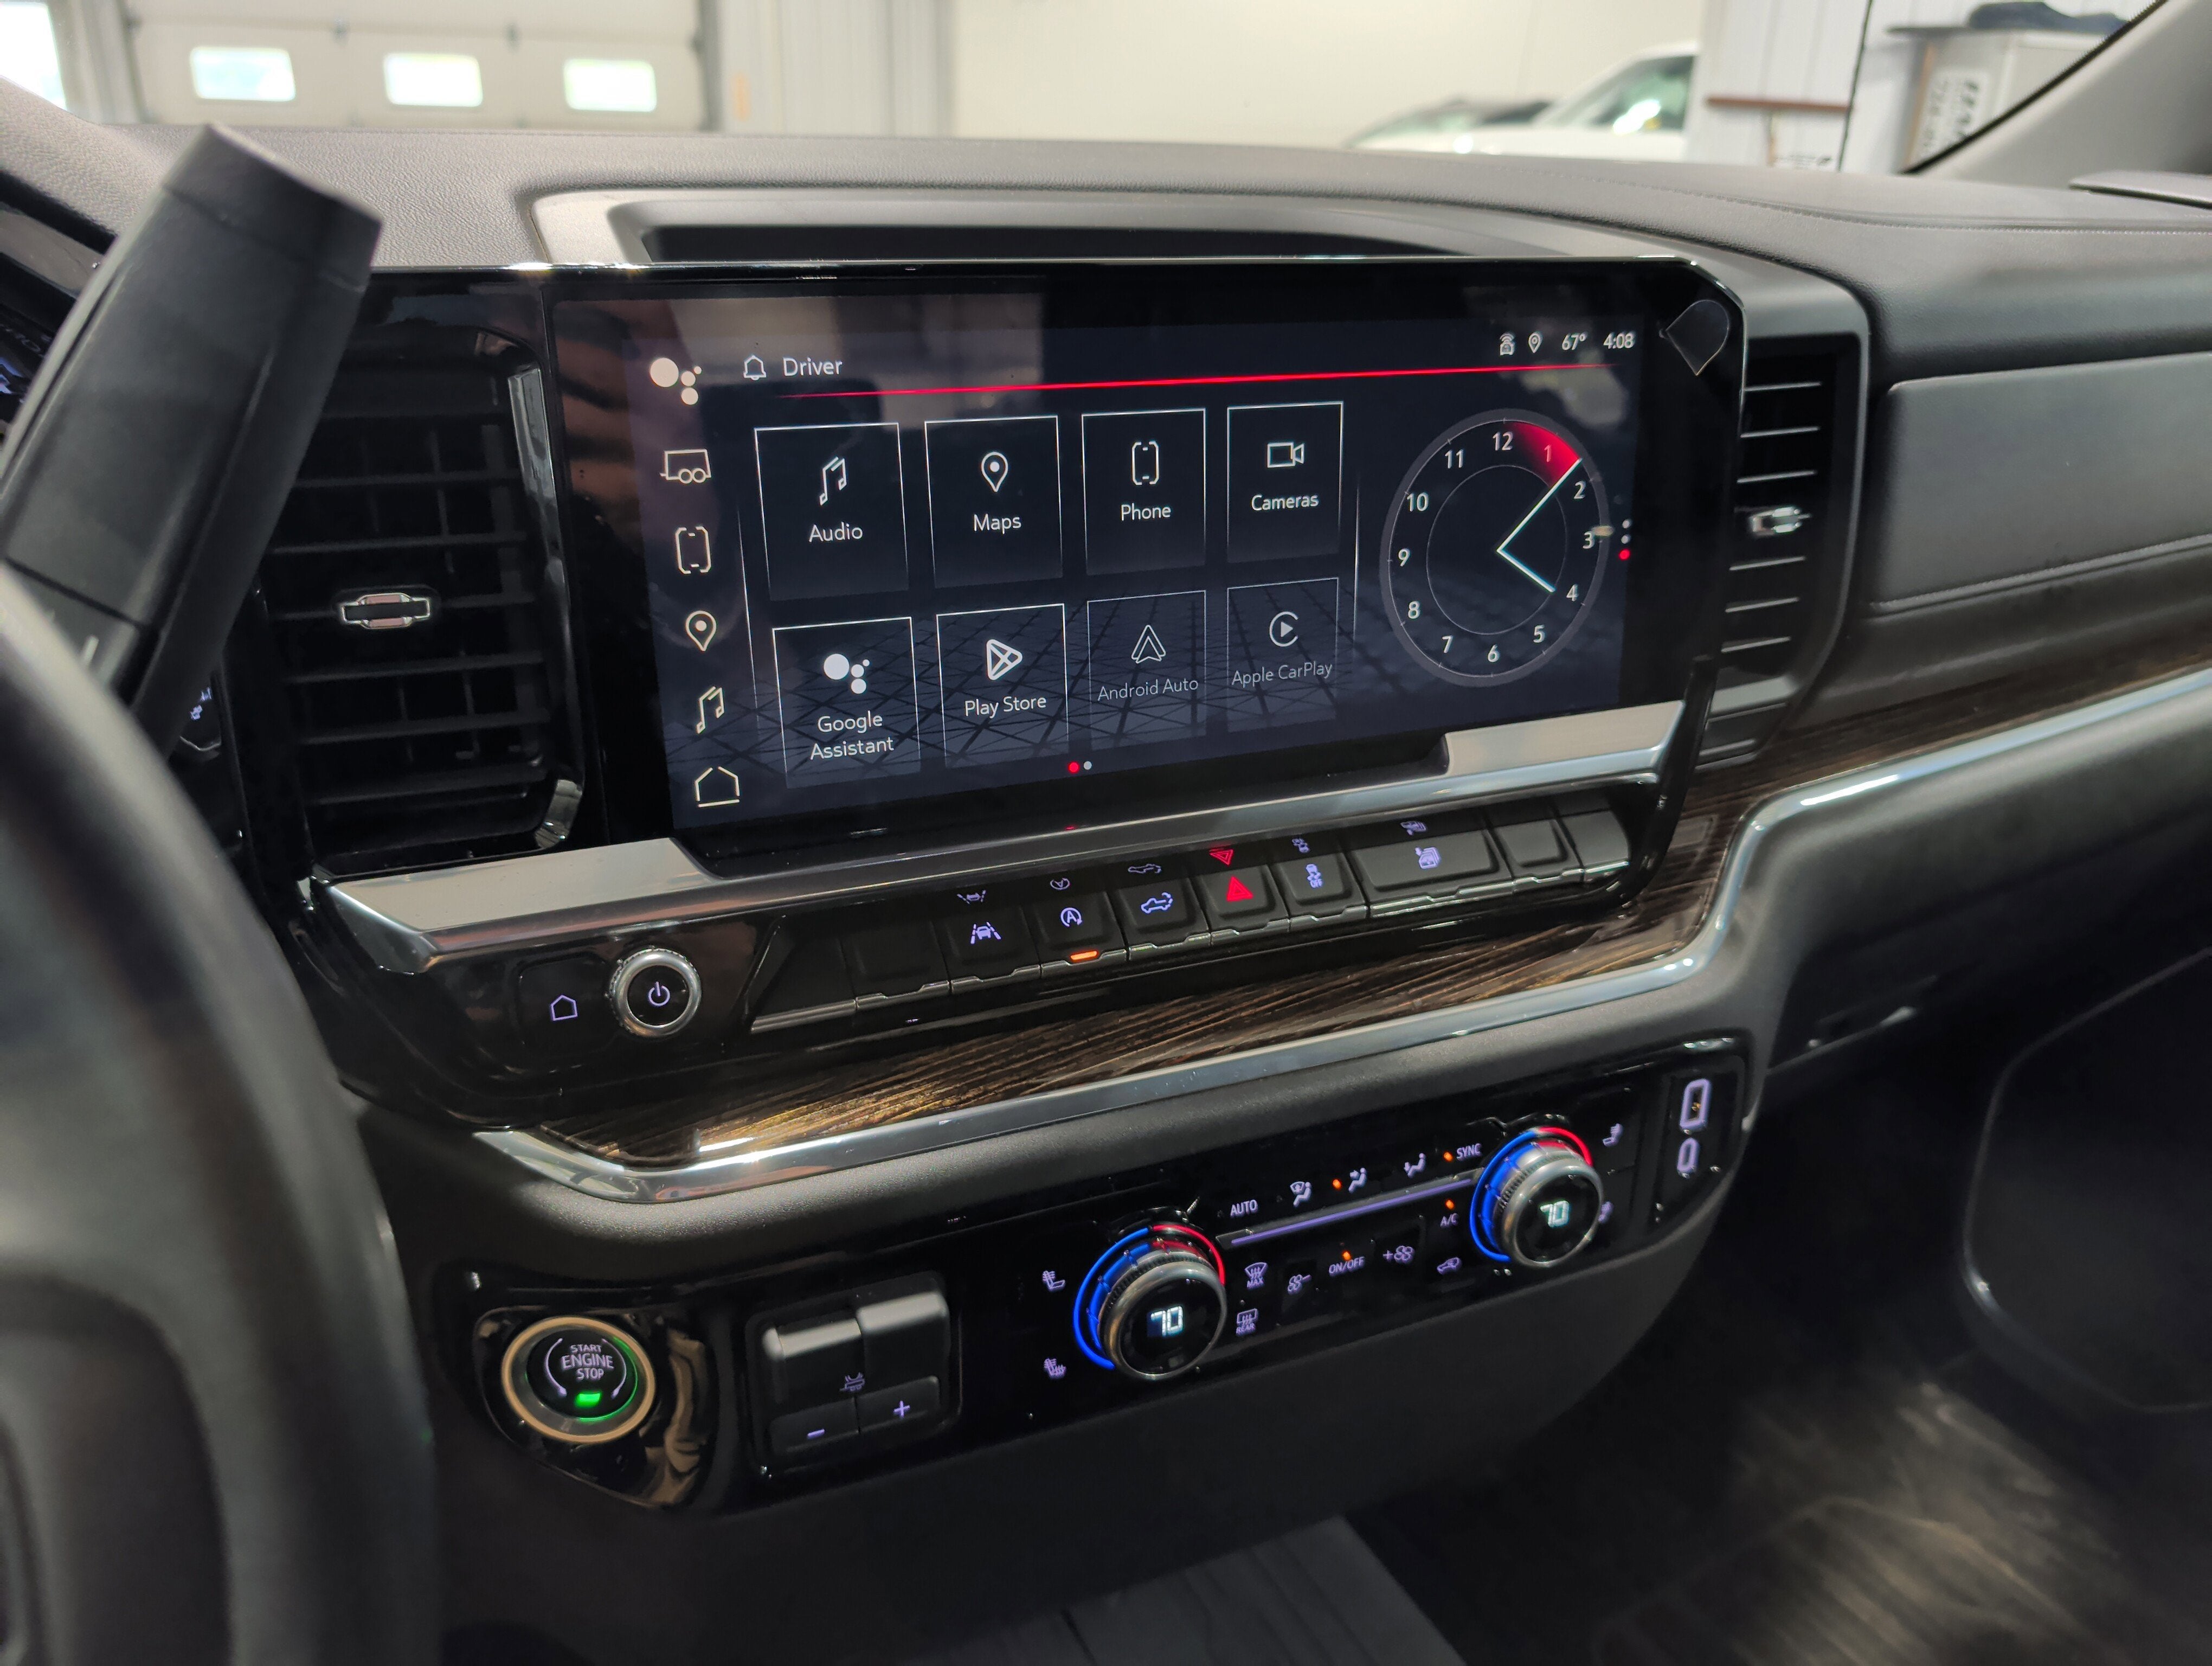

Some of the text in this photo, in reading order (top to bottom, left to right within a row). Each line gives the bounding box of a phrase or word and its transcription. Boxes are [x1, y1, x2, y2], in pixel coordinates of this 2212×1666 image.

[1604, 332, 1635, 349] 4:08
[783, 357, 843, 376] Driver
[1493, 432, 1513, 450] 12
[1445, 450, 1463, 469] 11
[1544, 445, 1552, 462] 1
[1574, 481, 1586, 499] 2
[1252, 495, 1319, 510] Cameras
[1409, 493, 1429, 511] 10
[1122, 503, 1171, 521] Phone
[809, 522, 863, 542] Audio
[974, 514, 1021, 534] Maps
[1583, 532, 1595, 549] 3
[1398, 549, 1410, 566] 9
[1566, 585, 1578, 601] 4
[1408, 601, 1420, 619] 8
[1534, 625, 1545, 643] 5
[1443, 636, 1452, 653] 7
[1488, 645, 1500, 662] 6
[1232, 661, 1332, 688] Apple CarPlay
[1098, 678, 1198, 701] Android Auto
[965, 696, 1046, 718] Play Store
[818, 710, 883, 733] Google
[811, 736, 894, 760] Assistant
[1457, 1143, 1480, 1159] SYNC
[1231, 1200, 1258, 1216] AUTO
[1540, 1201, 1570, 1227] 70
[1441, 1213, 1457, 1226] A/C
[1329, 1256, 1365, 1274] ON/OFF
[1150, 1306, 1183, 1336] 70
[570, 1344, 601, 1354] START
[561, 1353, 614, 1370] ENGINE
[576, 1368, 604, 1380] STOP
